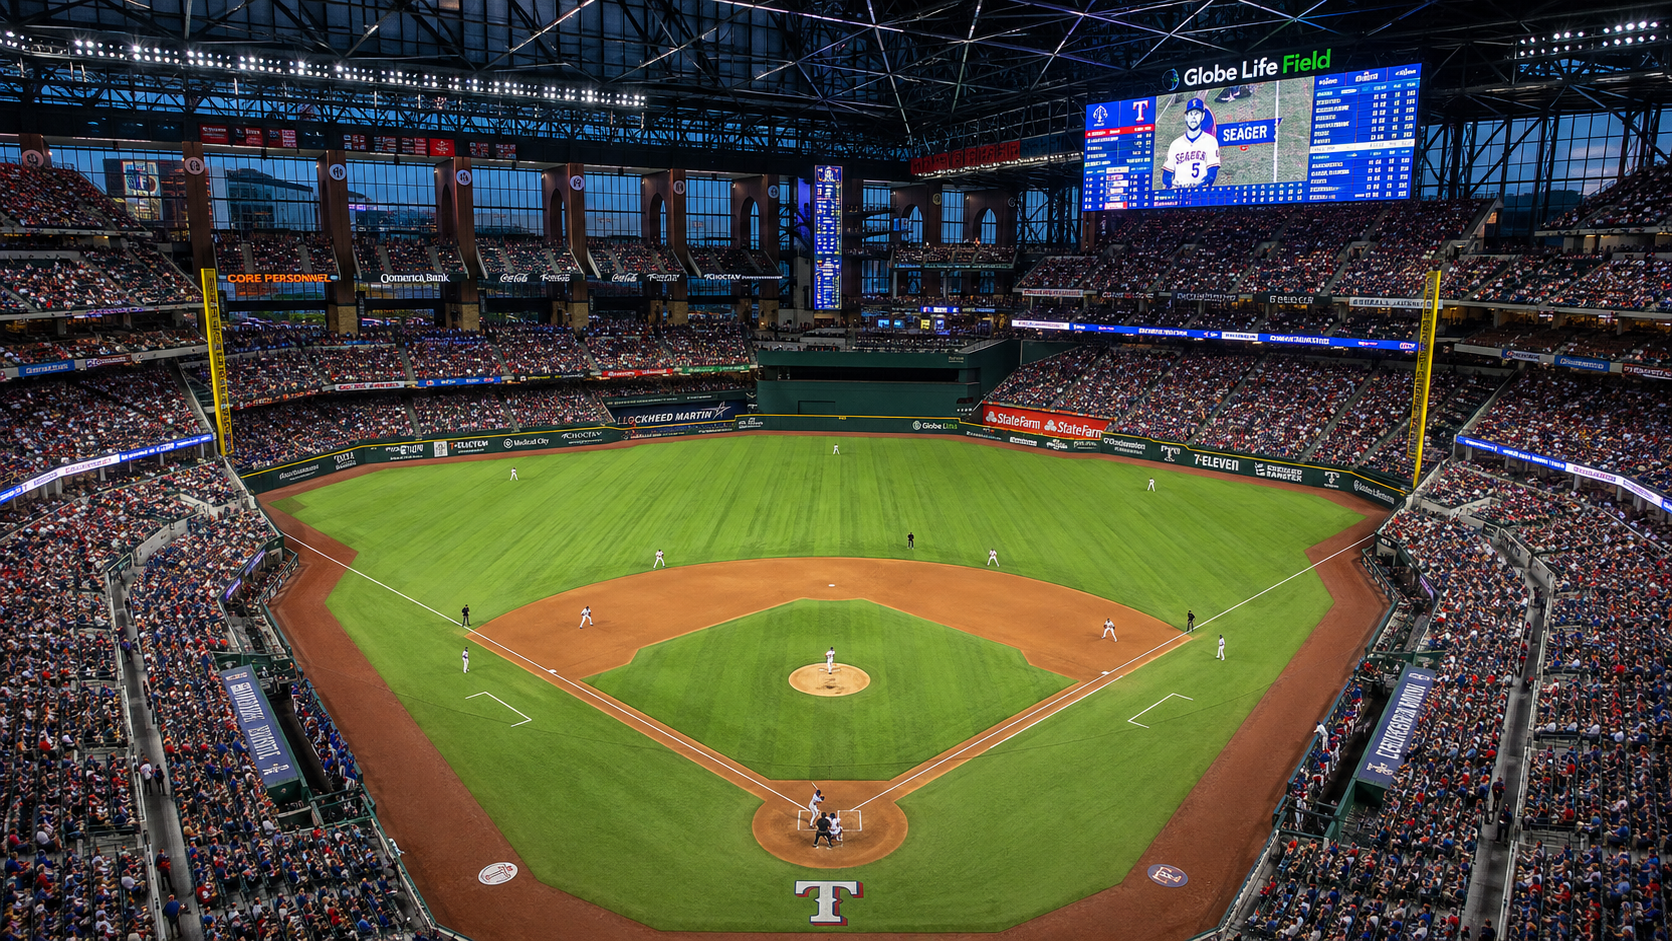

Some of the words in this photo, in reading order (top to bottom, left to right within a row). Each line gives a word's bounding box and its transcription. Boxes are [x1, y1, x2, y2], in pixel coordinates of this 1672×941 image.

[1183, 64, 1238, 86] Globe
[1241, 57, 1278, 79] Life
[1282, 48, 1331, 74] Field
[1223, 125, 1267, 142] SEAGER
[1191, 162, 1200, 178] 5
[227, 274, 262, 283] CORE
[674, 410, 713, 421] MARTIN
[922, 422, 942, 430] Globe
[794, 880, 864, 926] T
